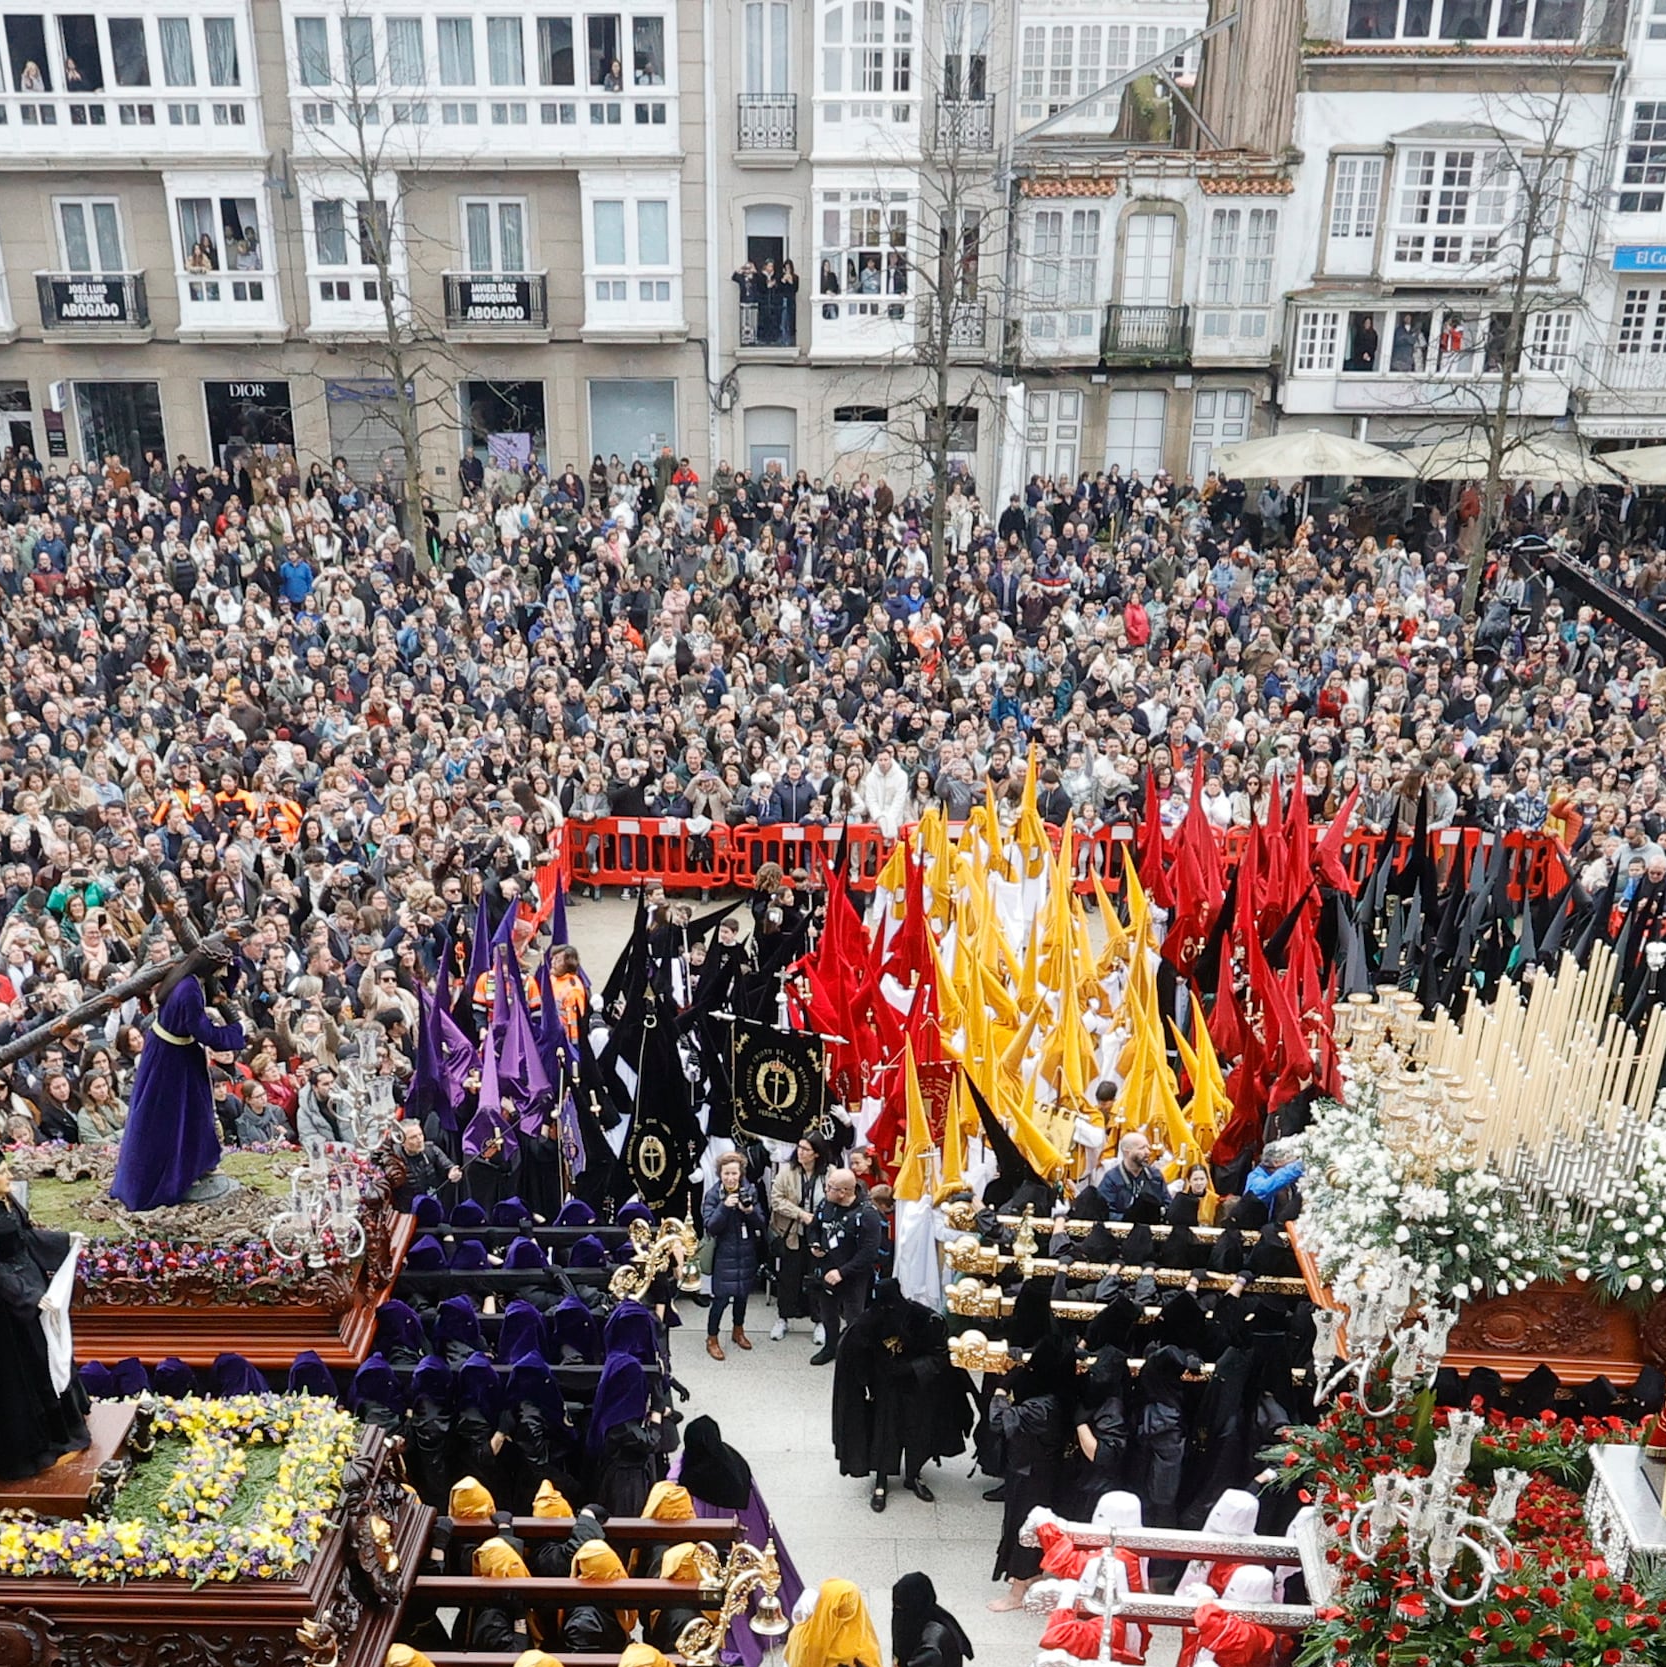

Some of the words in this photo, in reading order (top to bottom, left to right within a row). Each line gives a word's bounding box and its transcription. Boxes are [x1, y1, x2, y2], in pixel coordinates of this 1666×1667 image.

[1635, 252, 1648, 264] El
[69, 282, 88, 294] JOSÉ
[89, 284, 107, 294] LUIS
[471, 283, 496, 293] JAVIER
[498, 282, 517, 293] DÍAZ
[73, 294, 105, 303] SEOANE
[471, 293, 517, 304] MOSQUERA
[61, 303, 119, 317] ABOGADO
[467, 305, 524, 319] ABOGADO
[229, 383, 267, 397] DIOR
